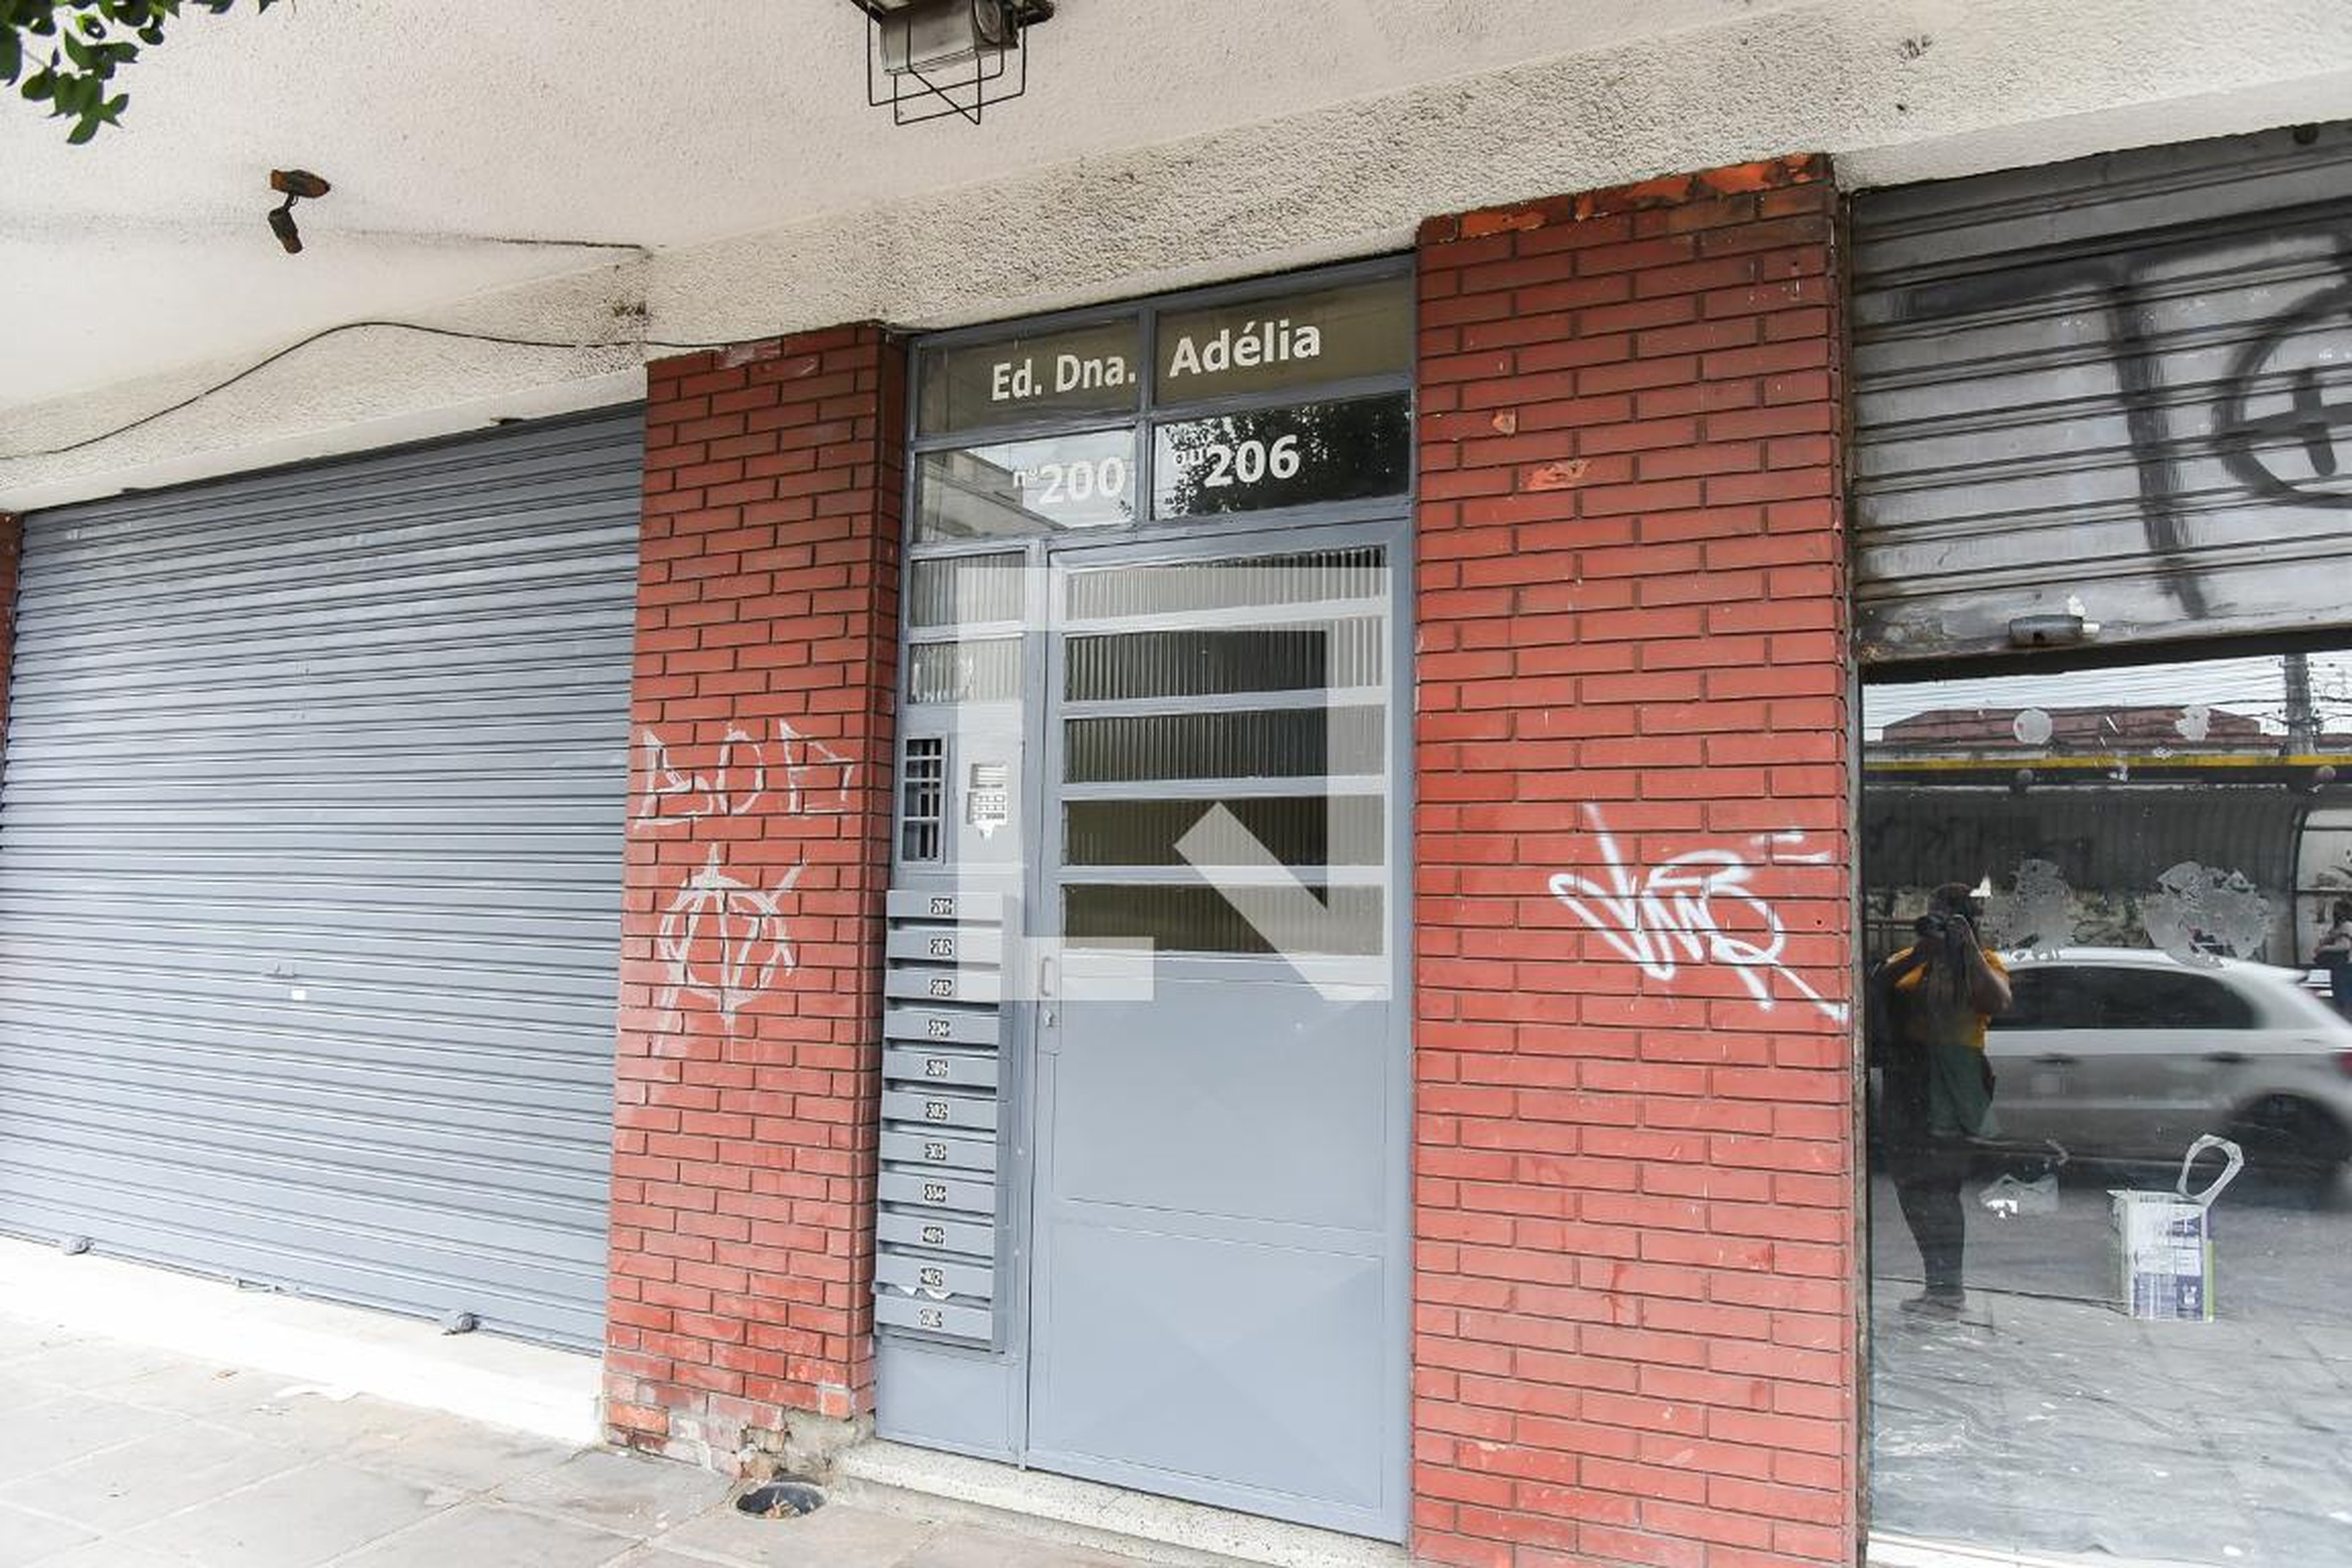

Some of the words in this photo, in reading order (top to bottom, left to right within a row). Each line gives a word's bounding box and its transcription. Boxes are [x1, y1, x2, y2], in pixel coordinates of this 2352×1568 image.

[991, 358, 1042, 402] Ed.
[1055, 353, 1137, 393] Dna.
[1169, 318, 1321, 378] Adélia
[1039, 457, 1125, 504] 200
[1204, 435, 1300, 488] 206
